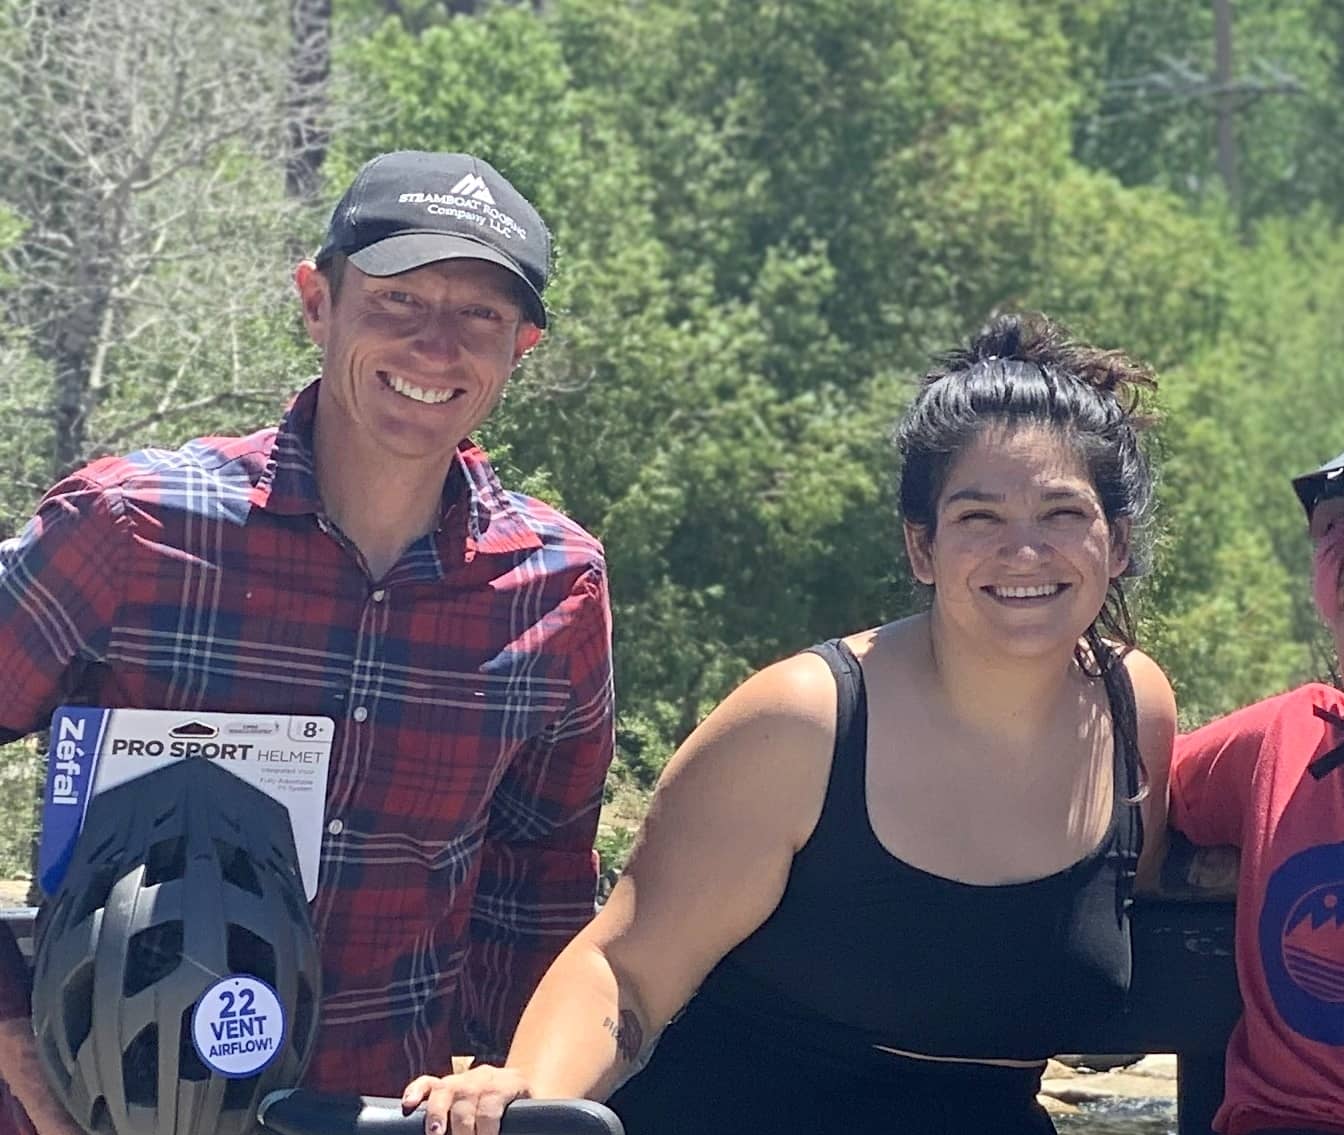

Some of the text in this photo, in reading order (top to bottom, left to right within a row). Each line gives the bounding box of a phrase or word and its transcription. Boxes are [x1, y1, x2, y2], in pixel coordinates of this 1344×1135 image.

[399, 193, 481, 210] STEAMBOAT
[427, 204, 512, 239] Company LLC
[53, 716, 85, 806] Zéfal
[111, 739, 323, 764] PRO SPORT HELMET
[219, 988, 256, 1019] 22
[210, 1015, 267, 1041] VENT
[208, 1037, 273, 1058] AIRFLOW!
